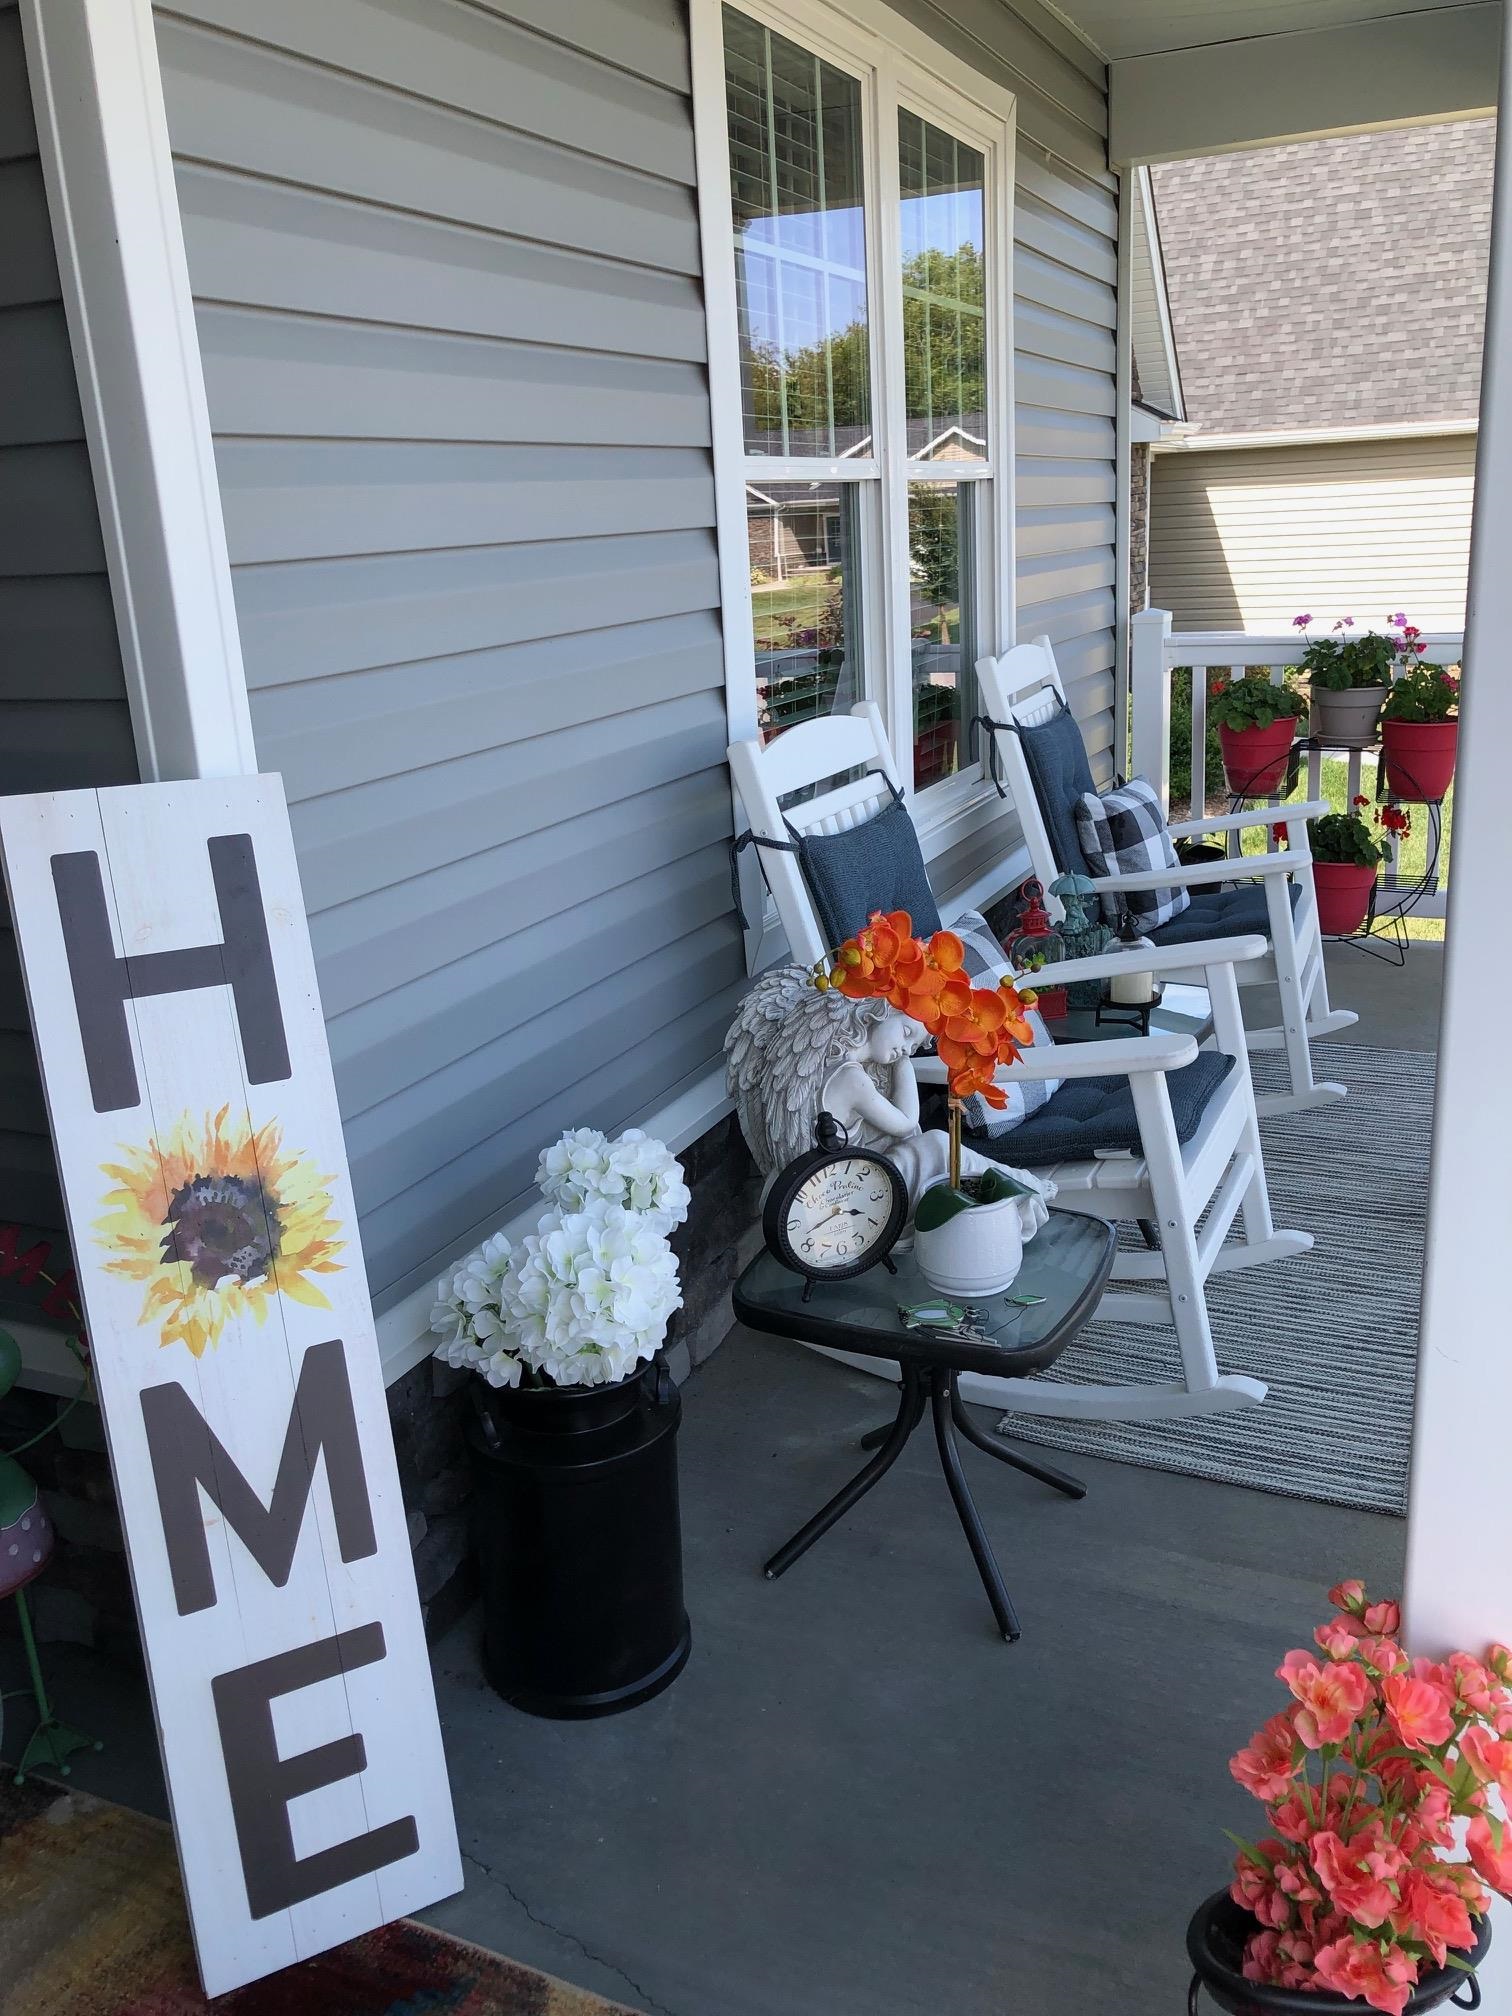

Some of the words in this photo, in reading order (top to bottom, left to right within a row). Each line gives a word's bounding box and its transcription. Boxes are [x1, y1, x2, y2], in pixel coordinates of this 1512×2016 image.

[823, 1164, 837, 1178] 12
[856, 1166, 871, 1181] 2
[794, 1189, 807, 1203] 10
[869, 1189, 884, 1202] 3
[786, 1218, 802, 1232] 9
[800, 1238, 815, 1252] 8
[851, 1231, 865, 1246] 5
[820, 1243, 832, 1258] 7
[836, 1240, 848, 1256] 6
